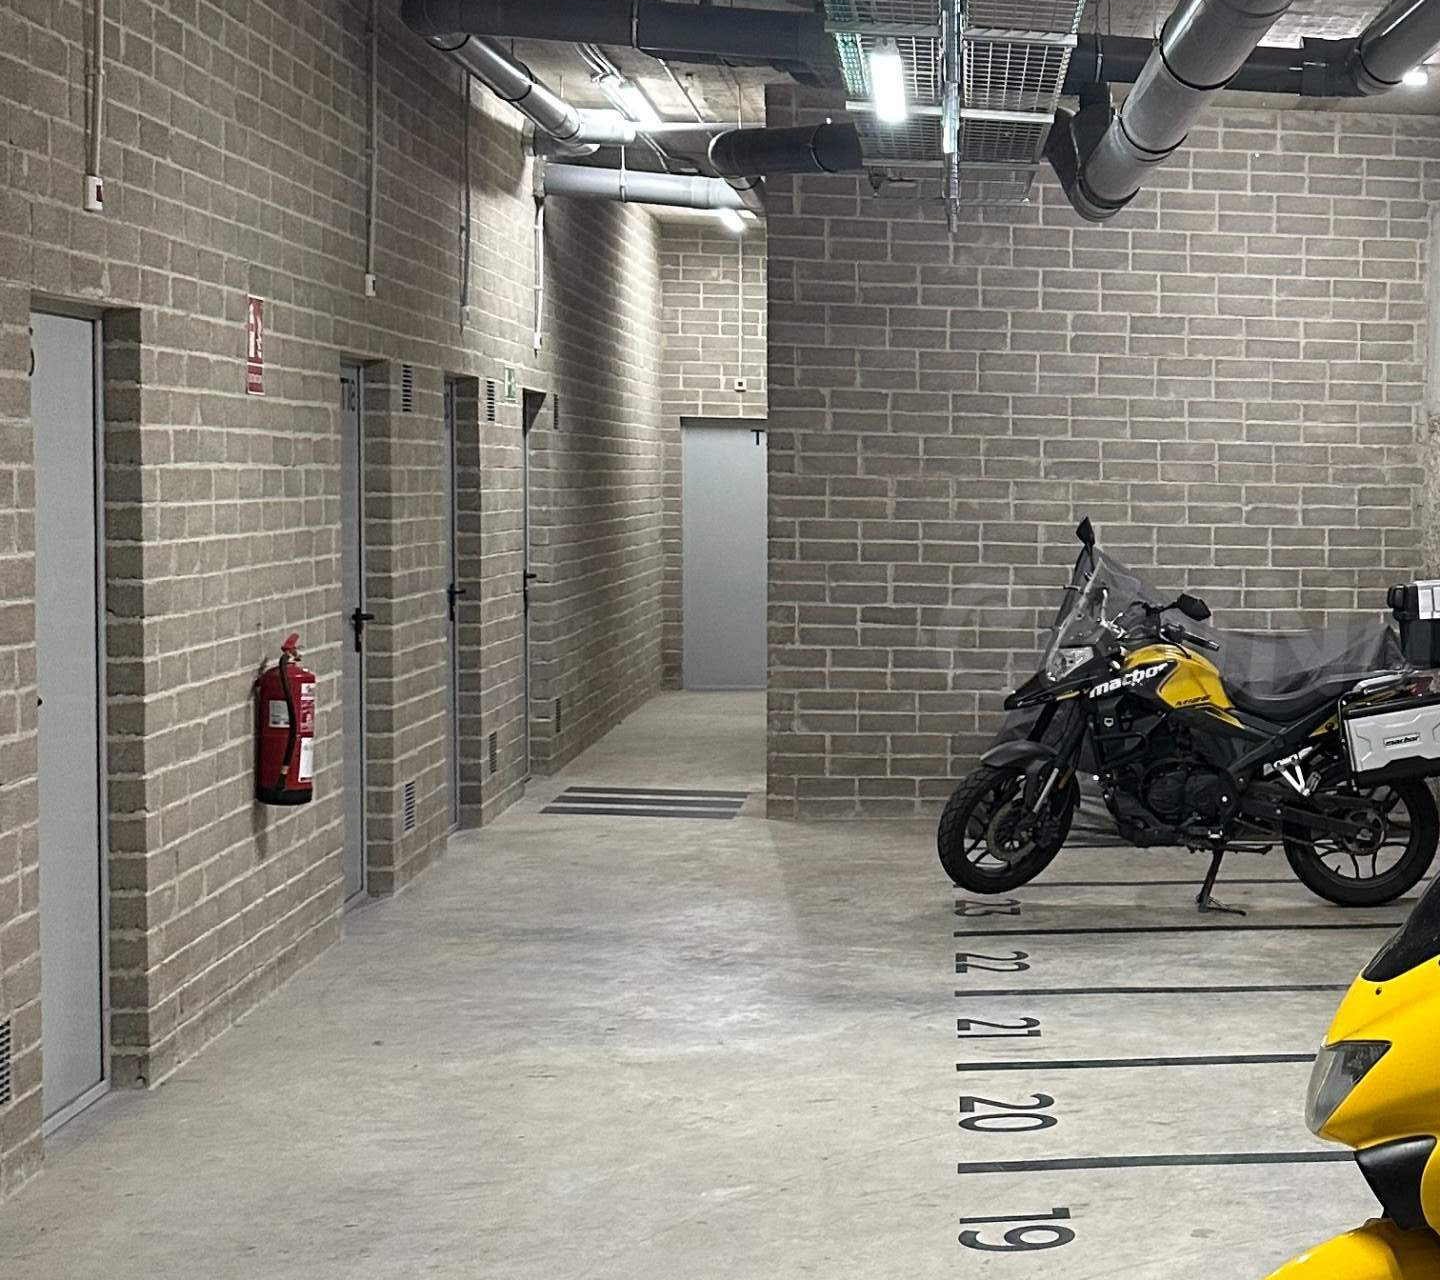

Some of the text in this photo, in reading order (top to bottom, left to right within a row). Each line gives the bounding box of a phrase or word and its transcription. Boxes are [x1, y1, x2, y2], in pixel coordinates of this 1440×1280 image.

[1088, 662, 1169, 699] macbor
[954, 899, 1022, 917] 23
[955, 951, 1031, 973] 22
[957, 1016, 1042, 1038] 21
[958, 1092, 1058, 1133] 20
[958, 1207, 1076, 1252] 19
